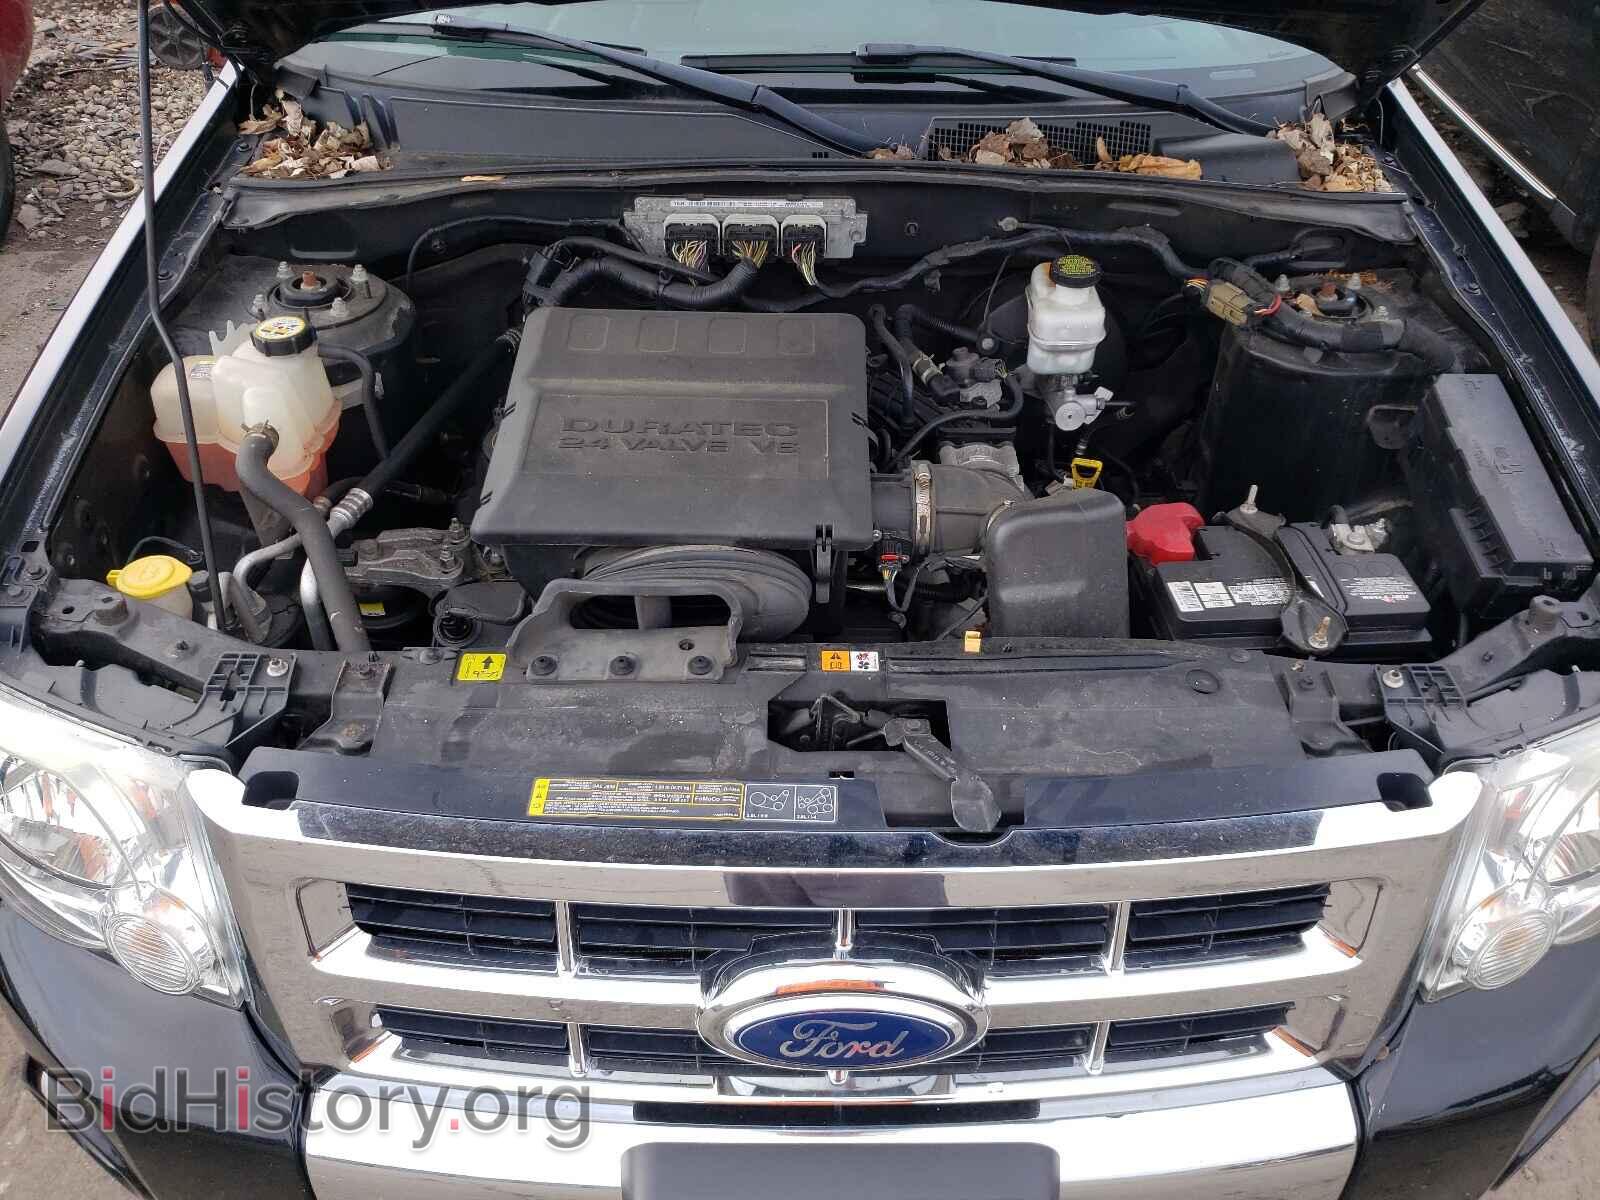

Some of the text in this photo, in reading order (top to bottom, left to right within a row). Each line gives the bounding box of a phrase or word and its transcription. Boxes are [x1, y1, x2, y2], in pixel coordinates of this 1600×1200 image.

[560, 418, 799, 437] DURATEC
[558, 437, 608, 450] 24
[622, 438, 729, 454] VALVE
[779, 1019, 909, 1058] Ford
